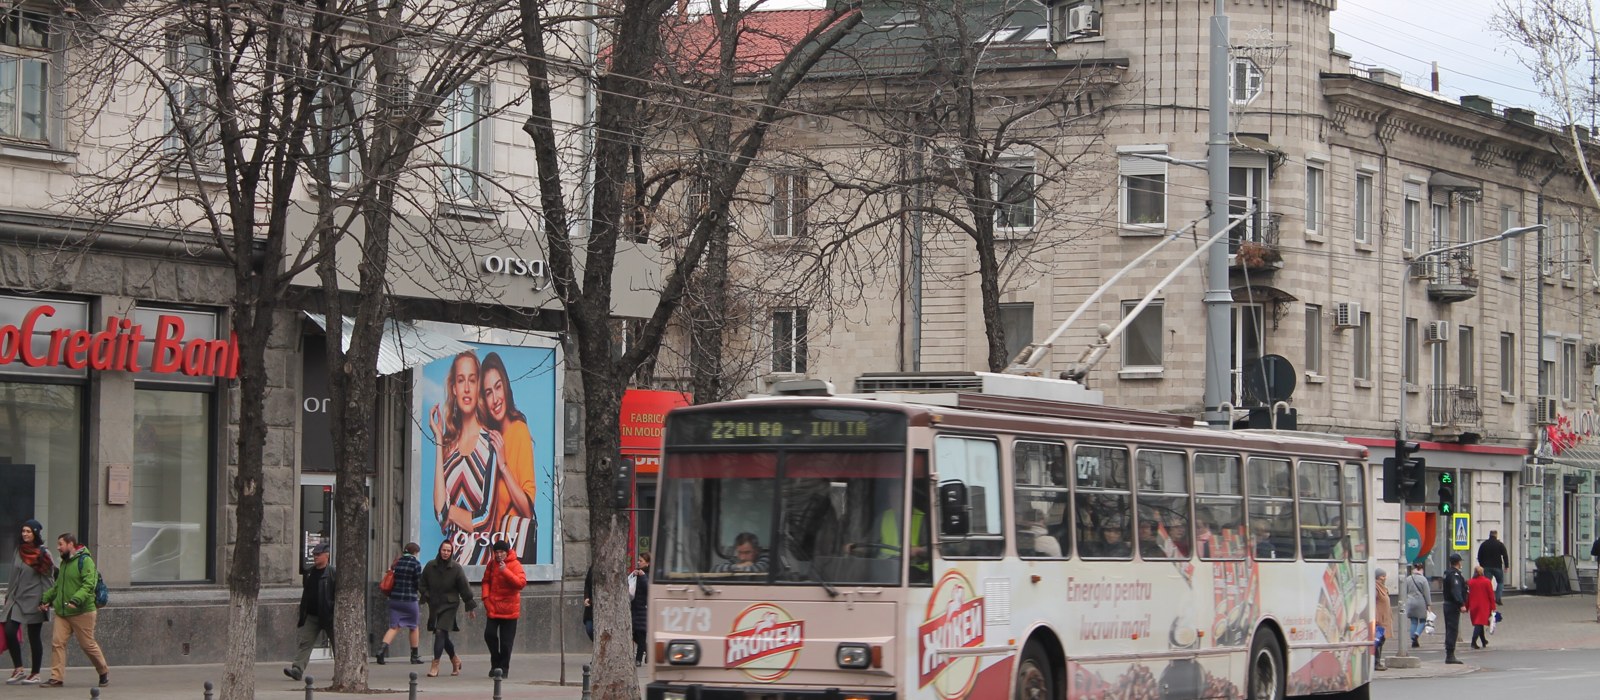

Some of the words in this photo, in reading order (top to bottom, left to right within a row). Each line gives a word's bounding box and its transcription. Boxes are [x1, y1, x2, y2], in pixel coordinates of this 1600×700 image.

[0, 304, 145, 374] oCredit
[622, 423, 633, 436] ÎN
[811, 420, 868, 437] IULIA
[1066, 576, 1112, 608] Energia
[1114, 578, 1152, 608] pentru
[660, 605, 712, 633] 1273
